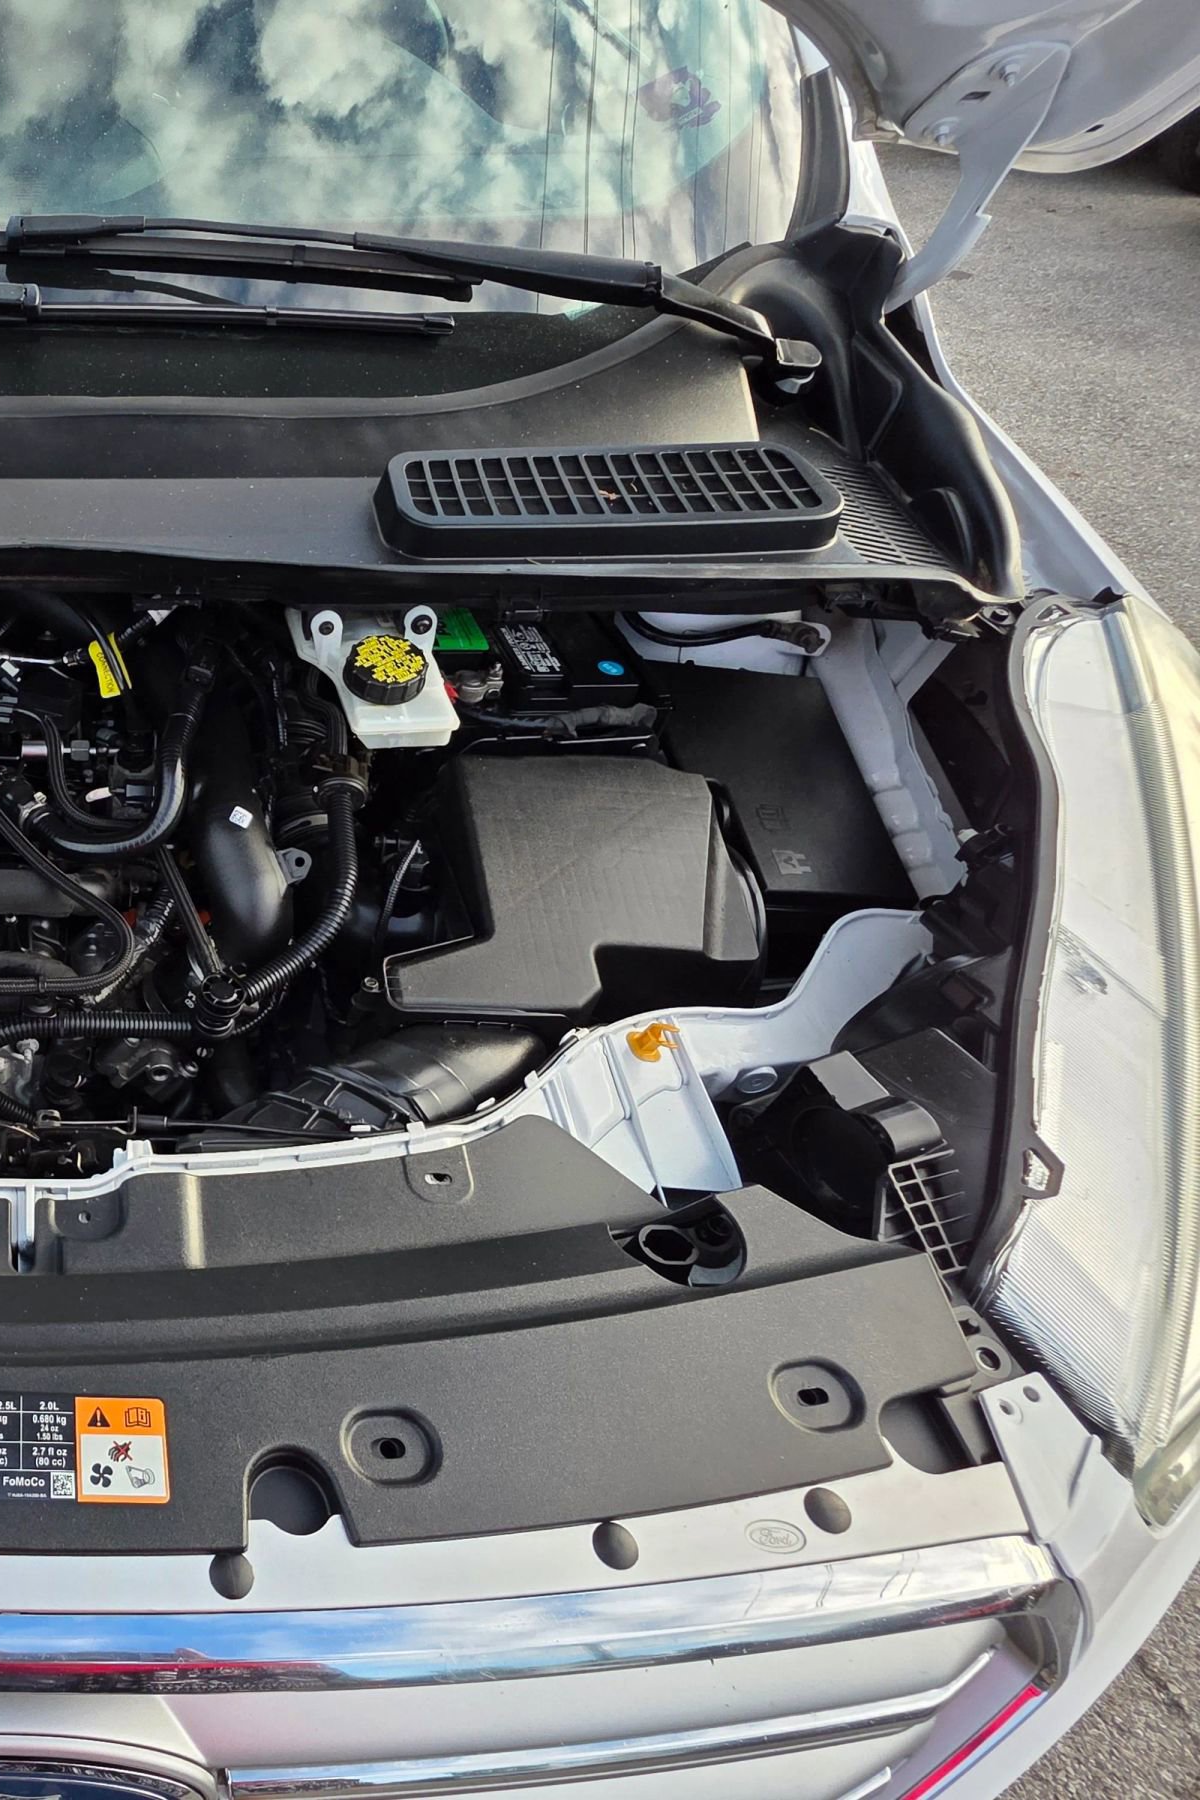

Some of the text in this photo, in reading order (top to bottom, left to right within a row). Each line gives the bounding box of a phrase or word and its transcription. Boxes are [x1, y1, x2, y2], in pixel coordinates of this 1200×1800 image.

[39, 1401, 60, 1411] 2.0L
[32, 1414, 67, 1426] 0.680 kg
[40, 1424, 49, 1432] 24
[36, 1432, 63, 1441] 1.50 lbs
[32, 1446, 68, 1457] 2.7 fl oz
[35, 1456, 66, 1468] (80 cc)
[2, 1476, 46, 1487] FoMoCo
[759, 1527, 792, 1547] Ford
